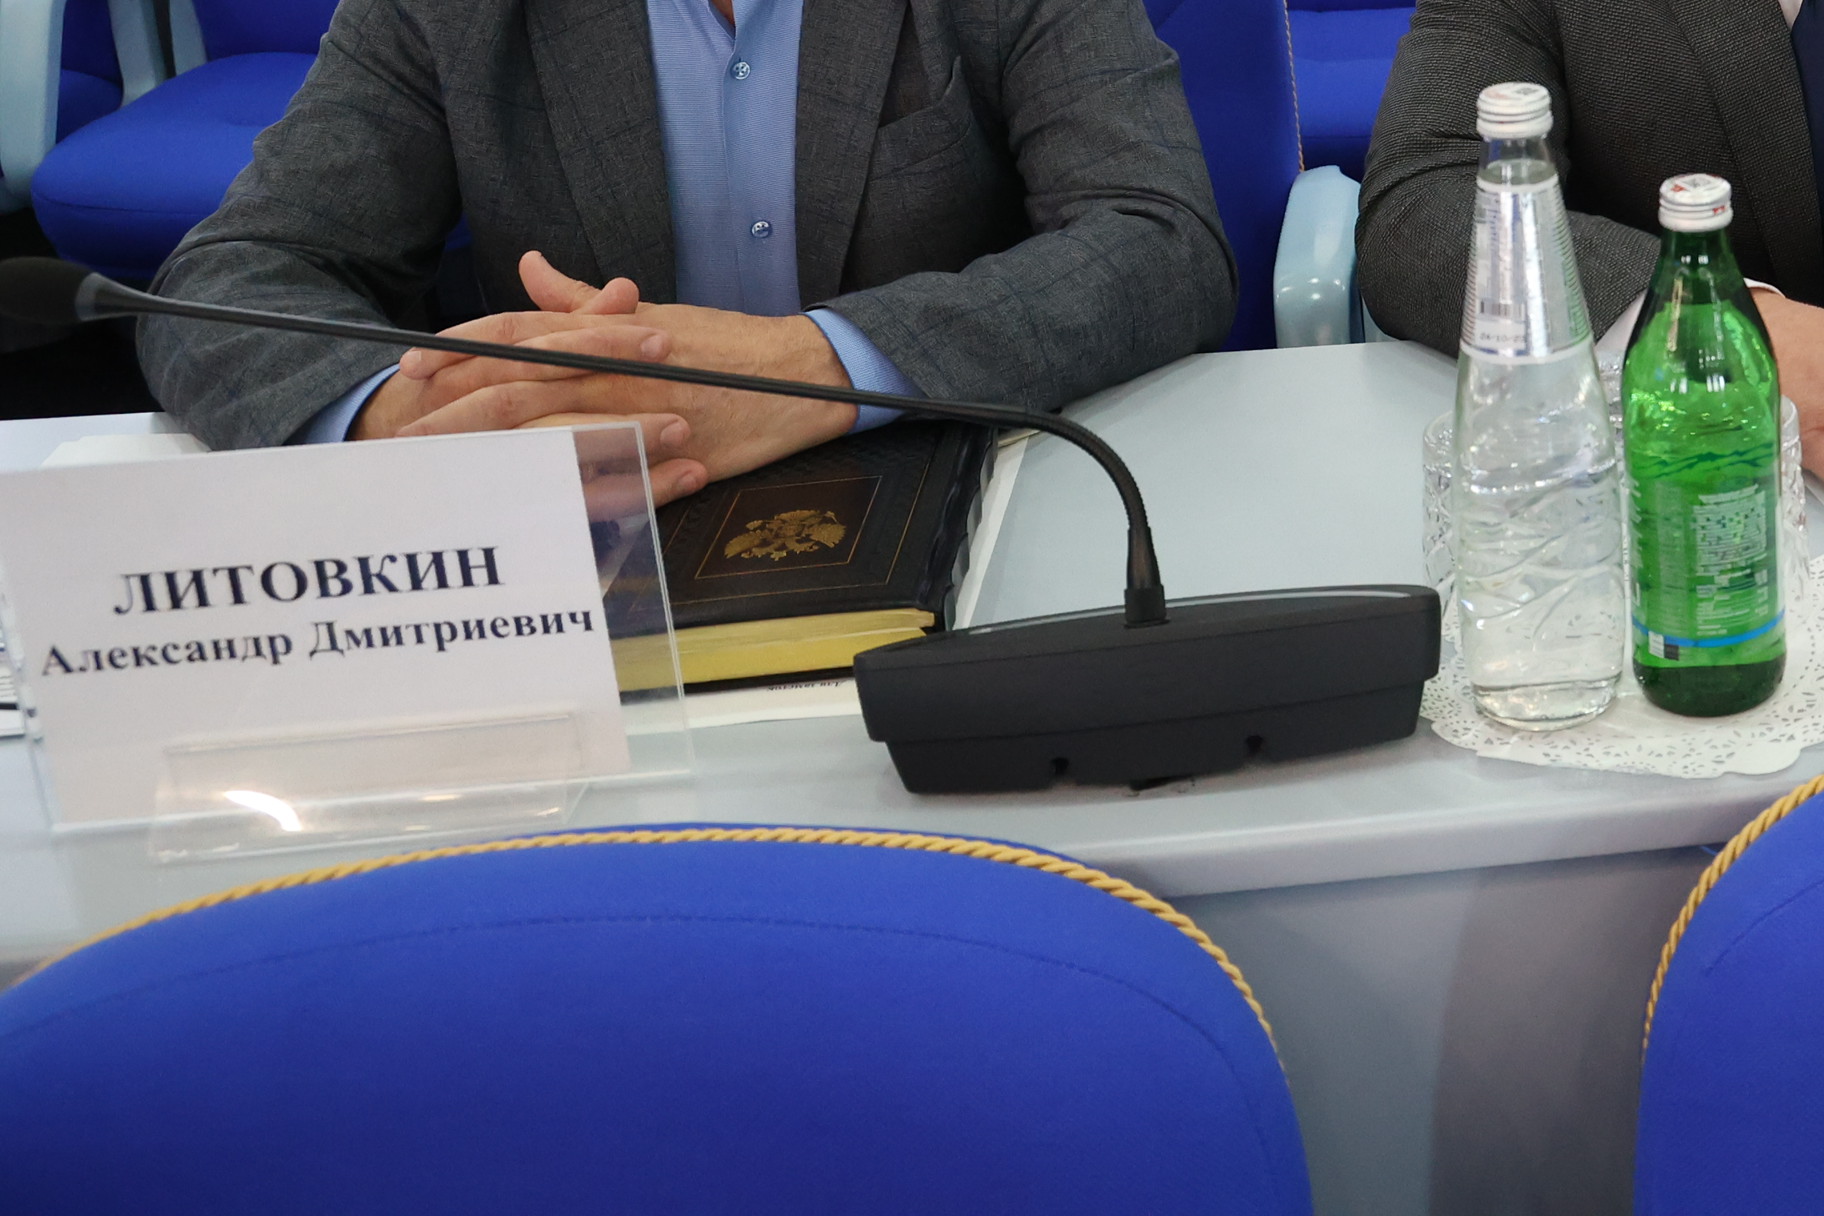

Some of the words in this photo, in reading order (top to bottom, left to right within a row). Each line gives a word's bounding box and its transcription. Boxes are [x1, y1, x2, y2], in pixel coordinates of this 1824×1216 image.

[113, 546, 503, 616] ЛИТОВКИН
[41, 633, 293, 676] Александр
[308, 609, 595, 659] Дмитриевич
